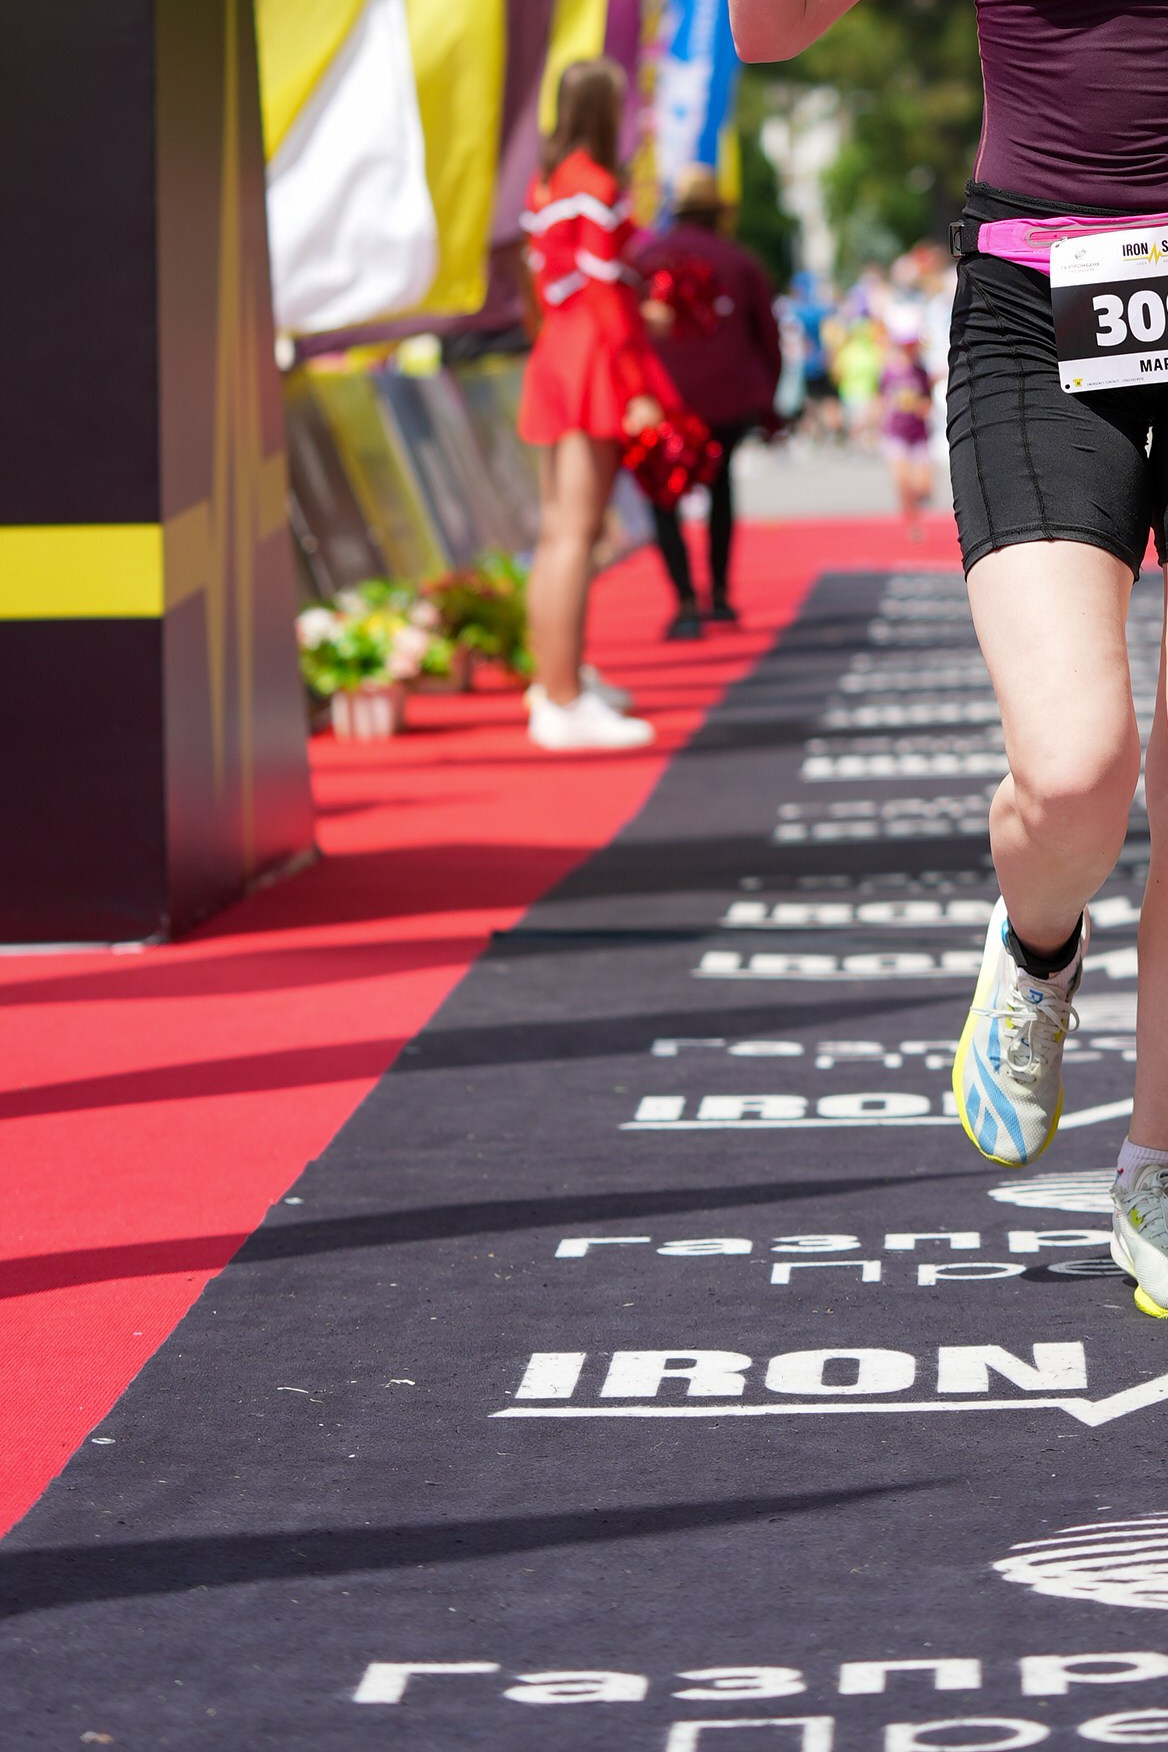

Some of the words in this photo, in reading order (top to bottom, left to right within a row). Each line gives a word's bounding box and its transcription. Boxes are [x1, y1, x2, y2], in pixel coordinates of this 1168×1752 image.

[1122, 242, 1149, 257] IRON
[635, 1092, 957, 1122] IRO
[516, 1341, 1089, 1401] IRON
